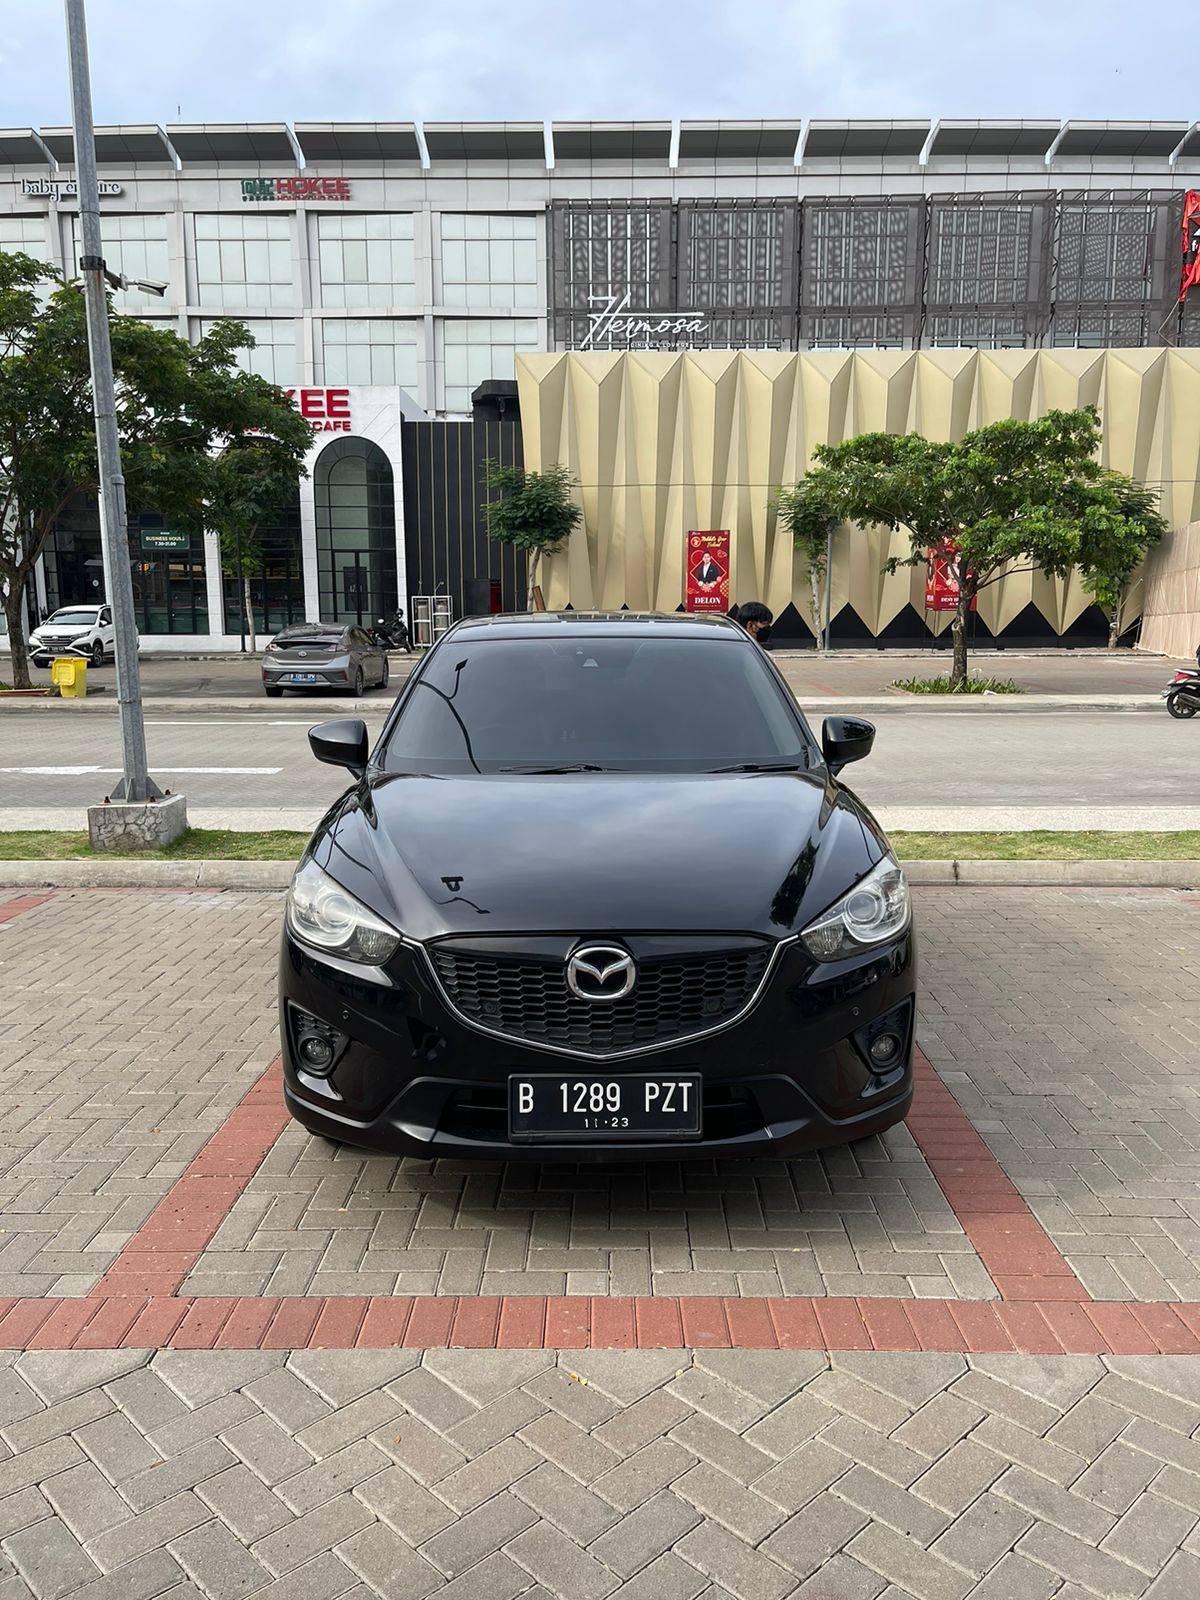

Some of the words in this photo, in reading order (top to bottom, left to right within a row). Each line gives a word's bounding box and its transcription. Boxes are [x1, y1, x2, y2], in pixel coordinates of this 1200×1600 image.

[21, 178, 60, 202] baby
[66, 182, 121, 194] eire
[276, 177, 350, 194] HOKEE
[580, 292, 709, 348] Hermosa
[312, 420, 351, 431] CAFE
[518, 1083, 534, 1114] B
[559, 1082, 621, 1113] 1289
[645, 1082, 693, 1113] PZT
